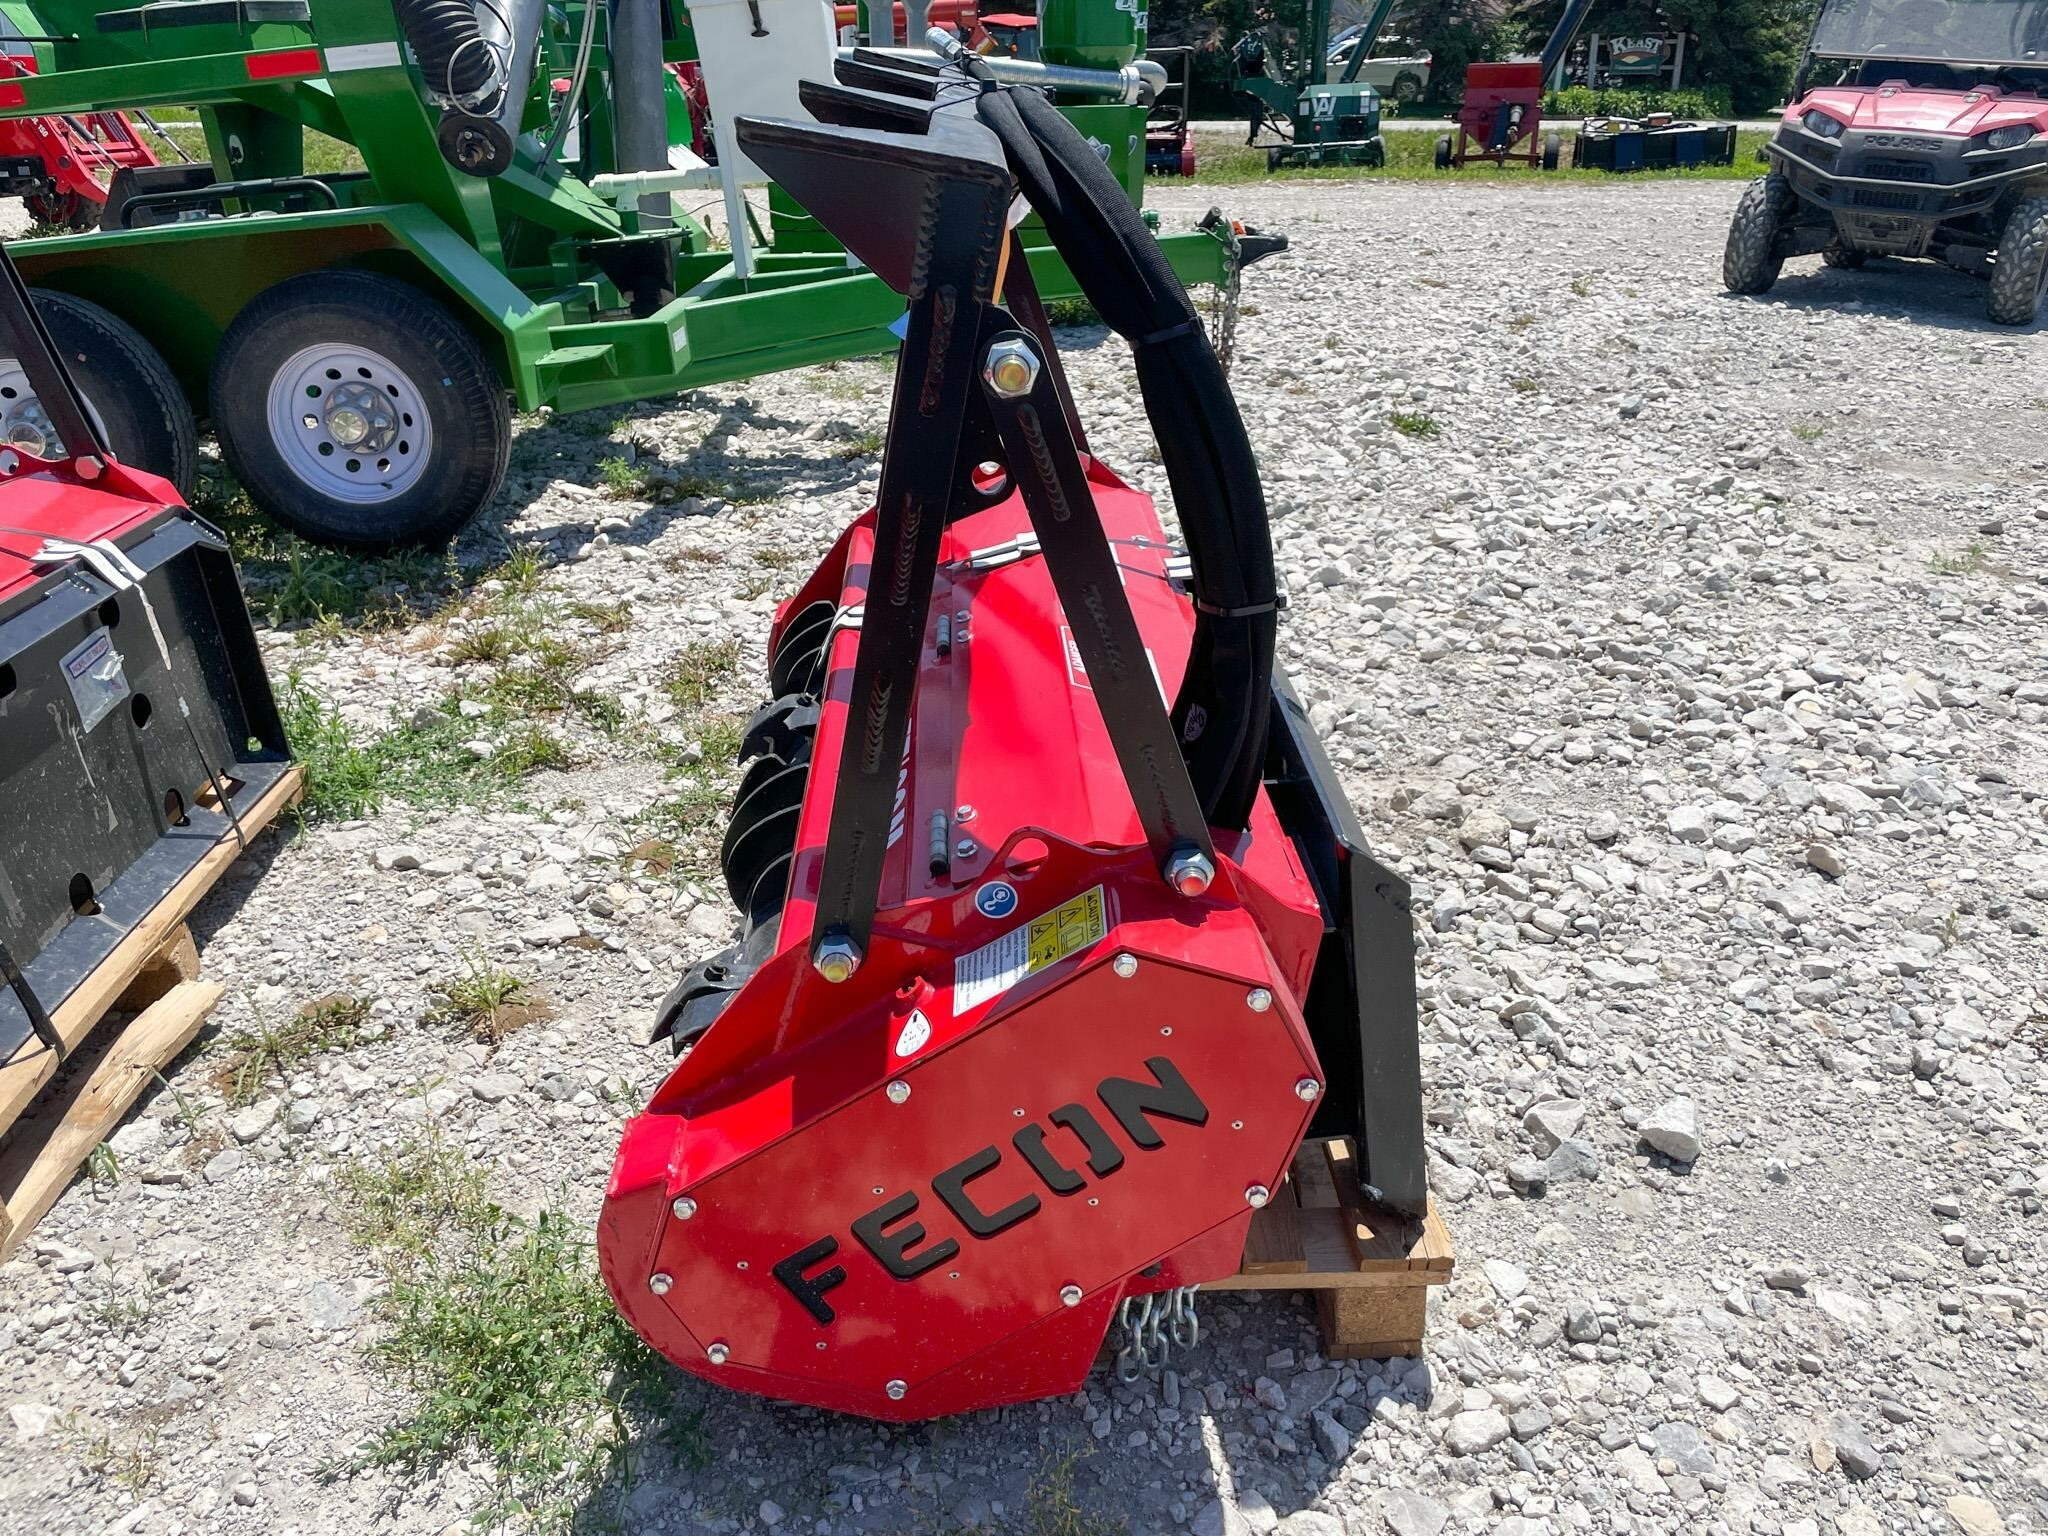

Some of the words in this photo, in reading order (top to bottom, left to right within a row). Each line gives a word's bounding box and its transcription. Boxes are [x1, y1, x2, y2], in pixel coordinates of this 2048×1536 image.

[1610, 36, 1663, 55] KEAST
[1863, 135, 1944, 152] POLARIS
[1087, 898, 1100, 938] CAUTION
[772, 1056, 1209, 1327] FECON
